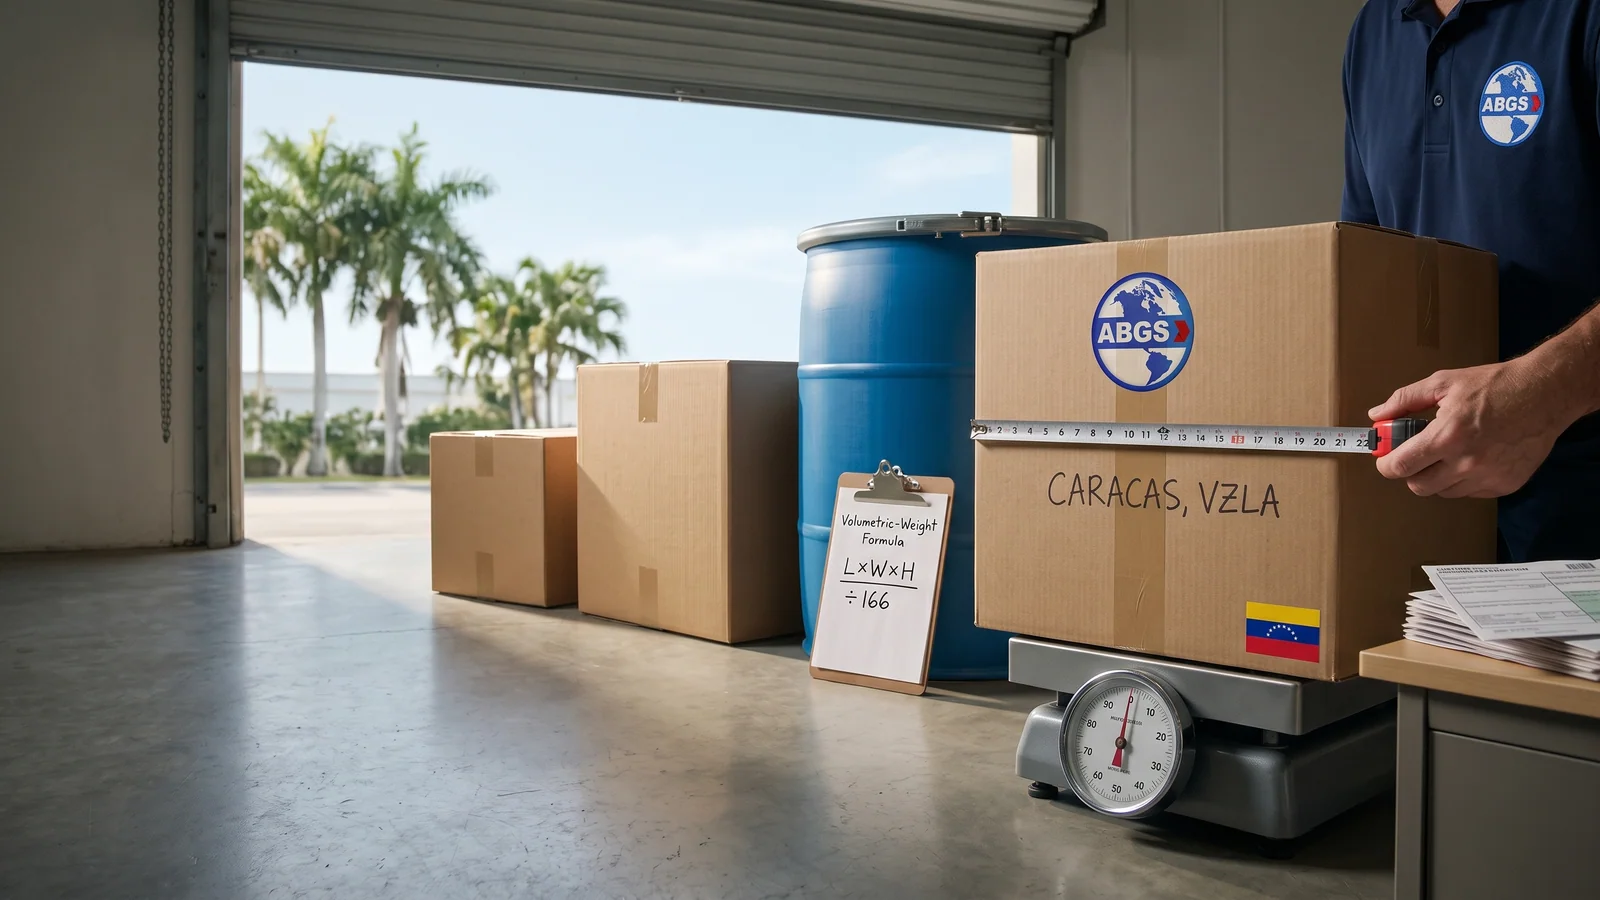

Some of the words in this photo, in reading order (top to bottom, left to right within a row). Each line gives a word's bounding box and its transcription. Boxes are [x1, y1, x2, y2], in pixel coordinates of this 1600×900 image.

[1481, 95, 1529, 112] ABGS
[1097, 320, 1170, 344] ABGS
[997, 426, 1003, 434] 2
[1012, 426, 1018, 435] 3
[1027, 427, 1033, 435] 4
[1043, 427, 1049, 436] 5
[1058, 428, 1065, 436] 6
[1074, 428, 1081, 437] 7
[1090, 429, 1096, 437] 8
[1106, 429, 1113, 438] 9
[1124, 430, 1135, 439] 10
[1141, 430, 1151, 439] 11
[1159, 433, 1169, 441] 12
[1178, 433, 1187, 442] 13
[1196, 434, 1205, 442] 14
[1215, 435, 1224, 443] 15
[1254, 436, 1263, 444] 17
[1274, 436, 1284, 445] 18
[1294, 437, 1305, 445] 19
[1313, 437, 1326, 446] 20
[1335, 438, 1346, 447] 21
[1356, 439, 1369, 447] 22
[1048, 471, 1188, 518] CARACAS,
[1198, 480, 1280, 518] VZLA
[842, 513, 938, 536] Volumetric-Weight
[862, 532, 905, 547] Formula
[1103, 700, 1114, 709] 90
[1128, 695, 1134, 704] 0
[1146, 707, 1155, 717] 10
[1086, 719, 1097, 728] 80
[1155, 732, 1167, 741] 20
[1083, 746, 1093, 756] 70
[1150, 761, 1162, 771] 30
[1092, 771, 1103, 780] 60
[1111, 784, 1122, 794] 50
[1133, 781, 1145, 790] 40
